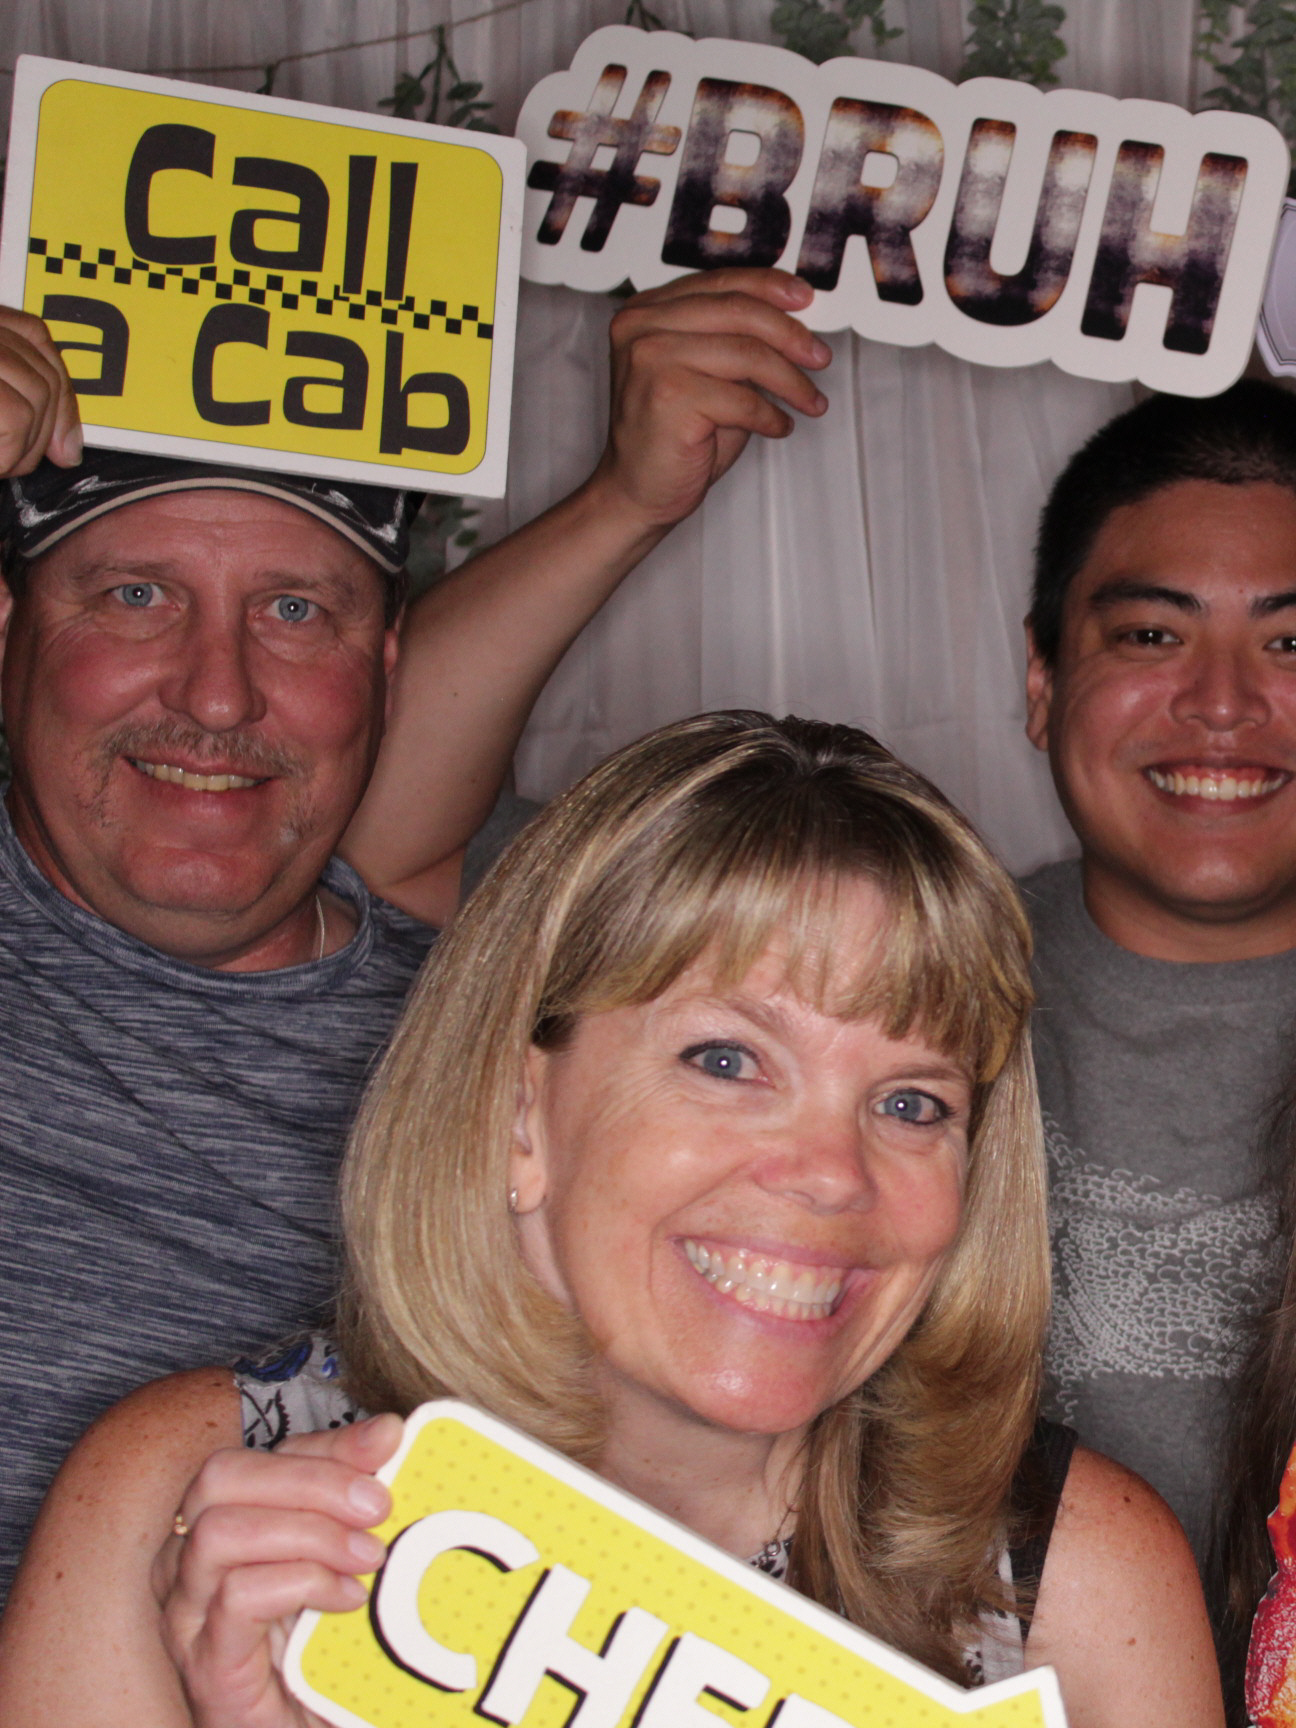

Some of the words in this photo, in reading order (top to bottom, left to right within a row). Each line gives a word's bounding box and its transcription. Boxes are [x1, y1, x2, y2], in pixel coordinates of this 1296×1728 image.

[125, 124, 418, 300] Call
[527, 64, 1249, 355] #BRUH
[42, 295, 130, 397] a
[193, 303, 470, 455] Cab
